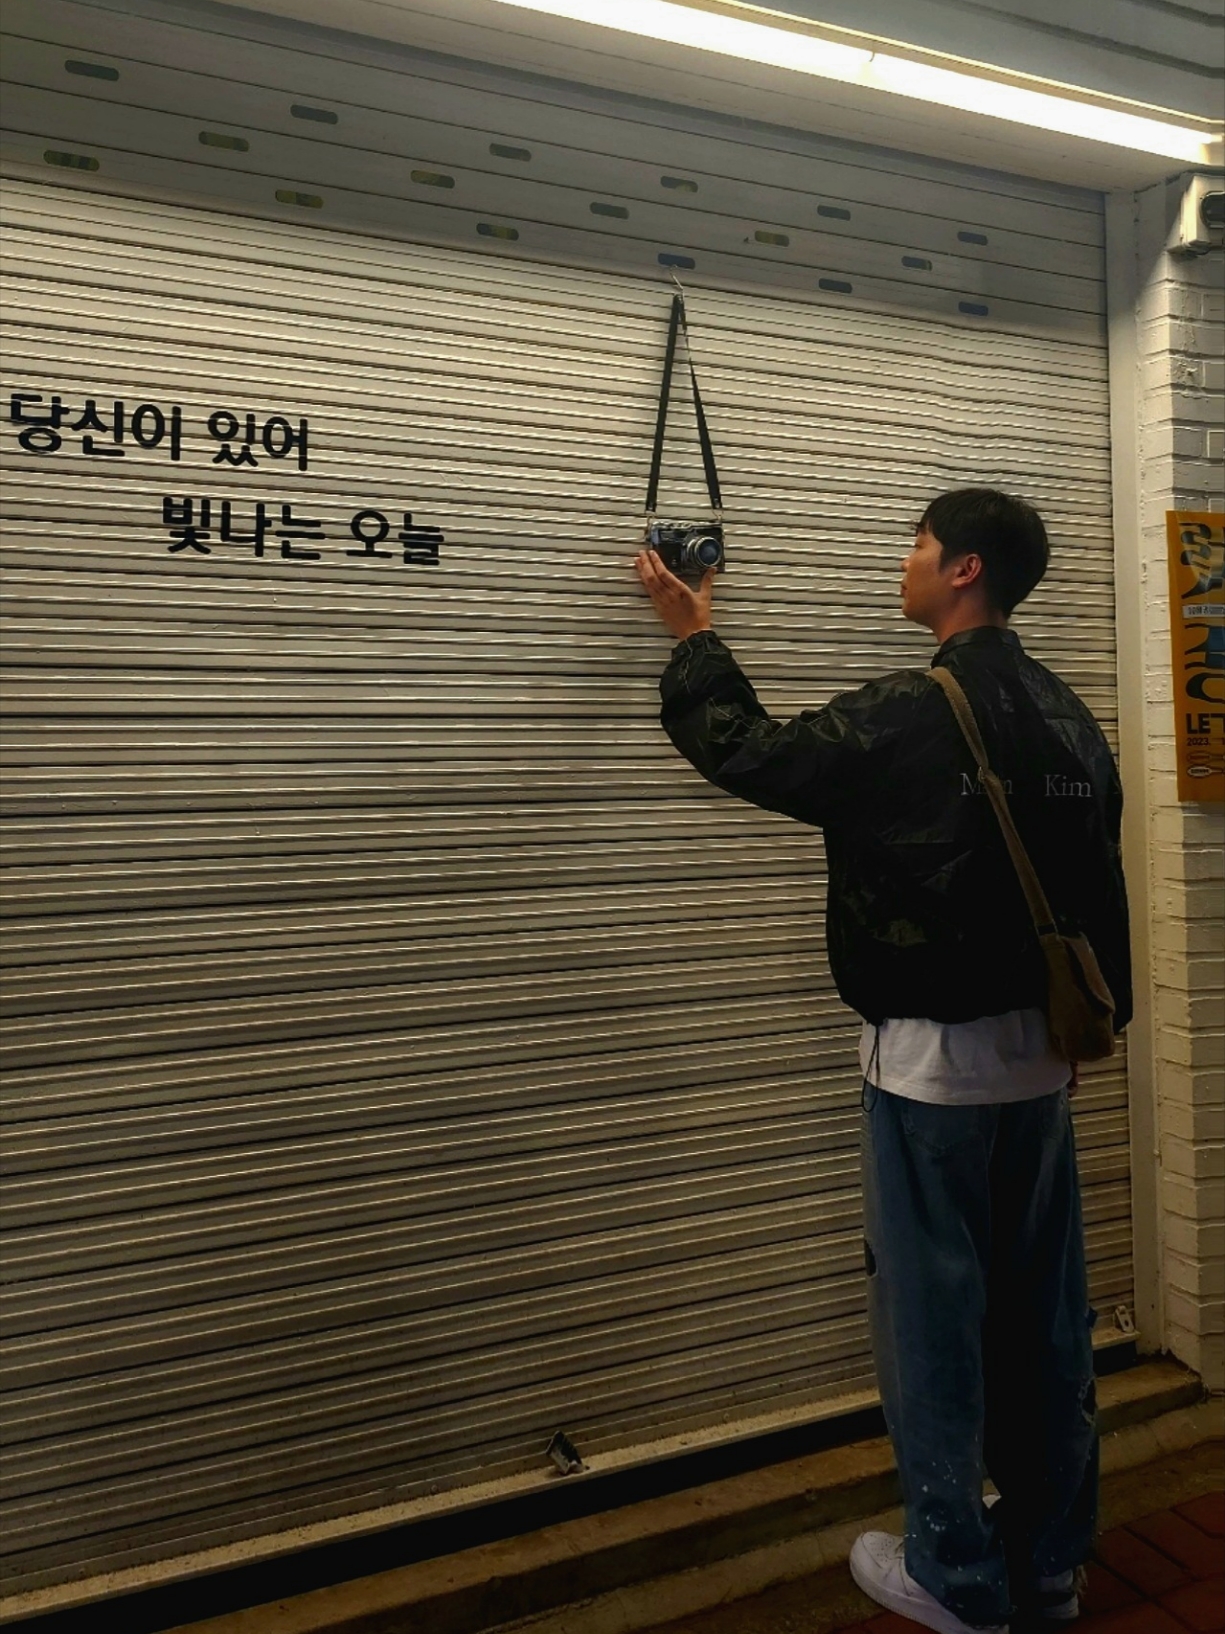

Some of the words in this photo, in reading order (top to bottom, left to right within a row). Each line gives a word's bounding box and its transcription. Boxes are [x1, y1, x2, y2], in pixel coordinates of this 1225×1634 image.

[11, 393, 181, 461] 당신이
[207, 411, 308, 471] 있어
[162, 497, 325, 557] 빛나는
[346, 510, 444, 566] 오늘
[1044, 774, 1092, 797] Kim
